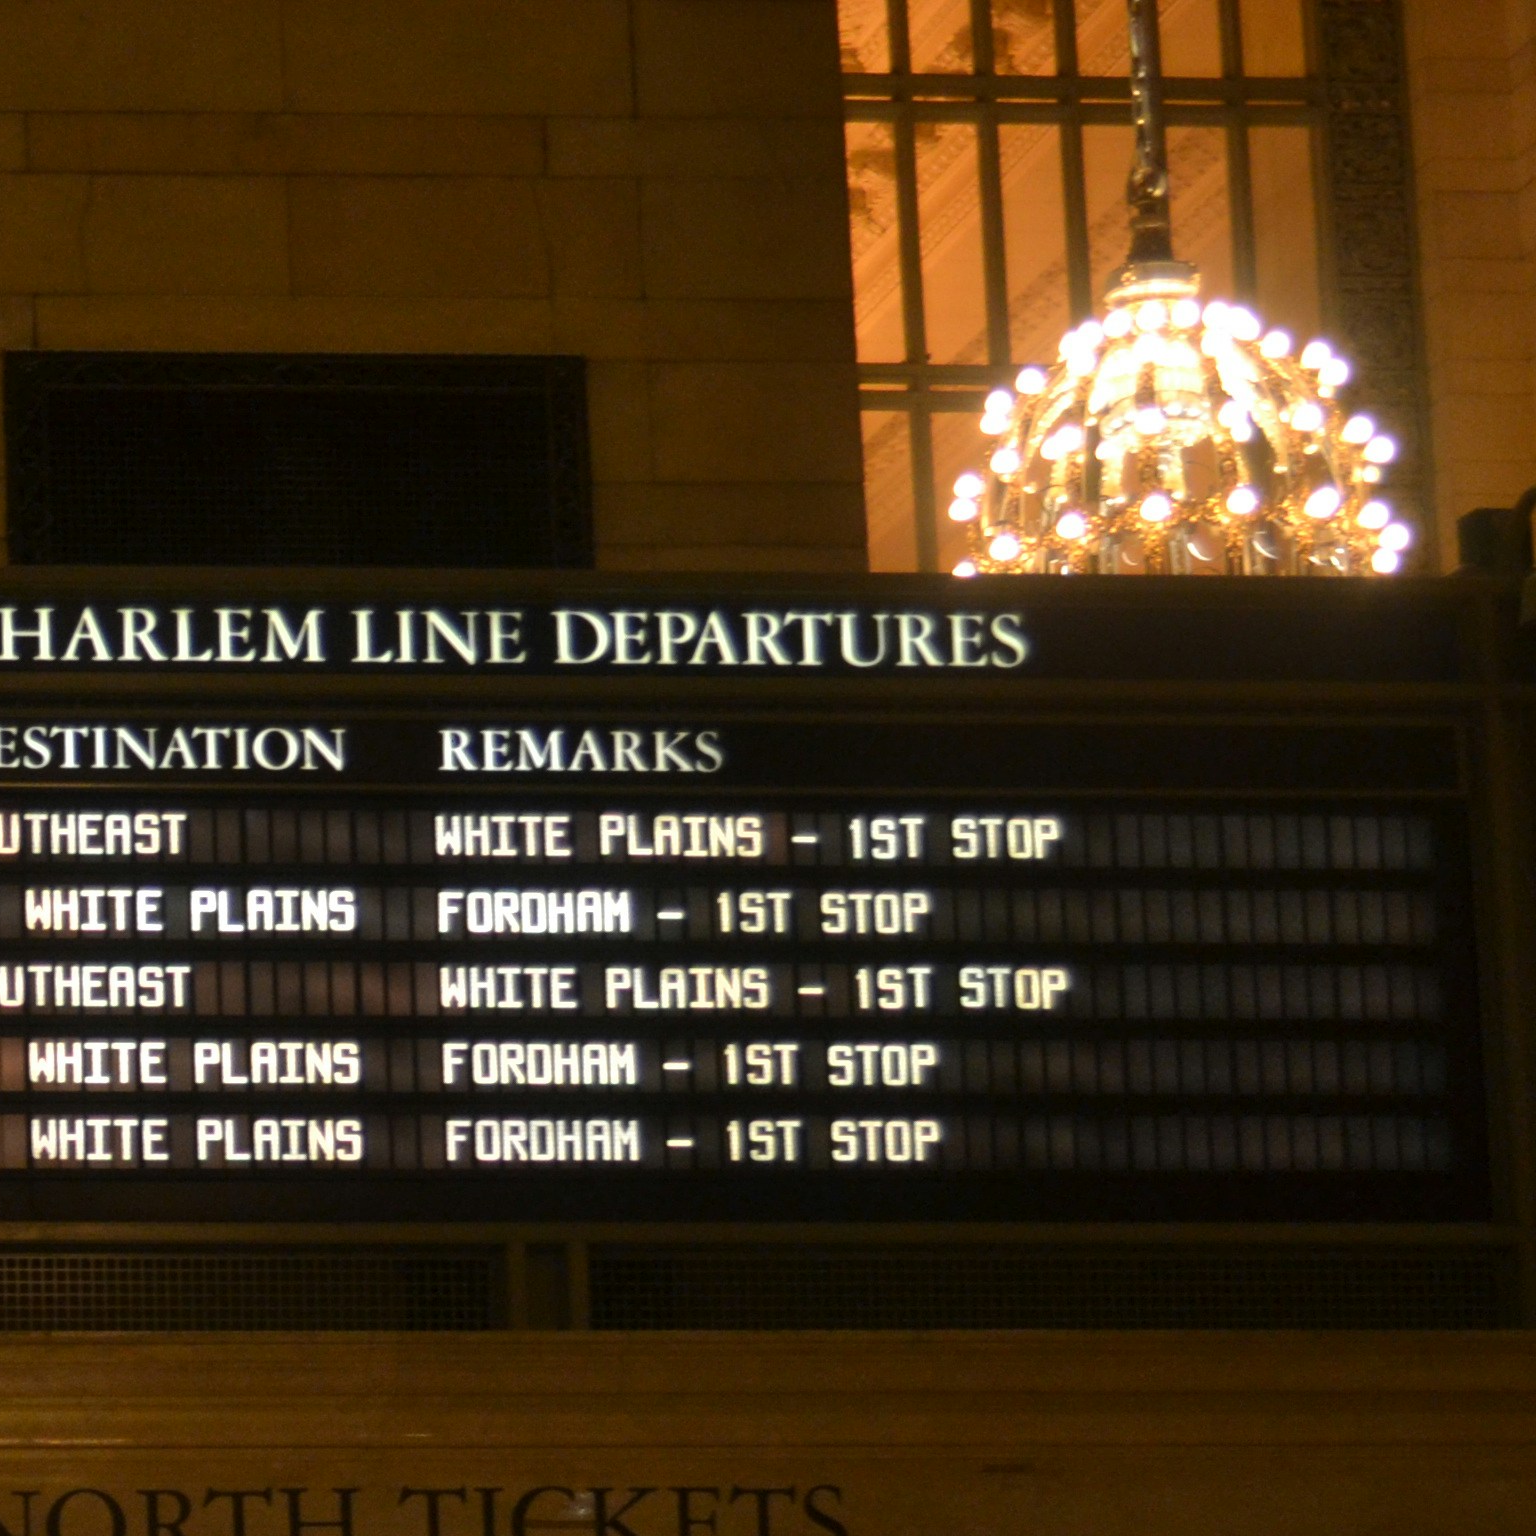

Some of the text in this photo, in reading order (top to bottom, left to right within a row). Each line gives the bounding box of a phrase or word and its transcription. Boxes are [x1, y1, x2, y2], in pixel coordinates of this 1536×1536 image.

[351, 608, 526, 664] LINE
[551, 609, 1028, 668] DEPARTURES
[437, 728, 724, 773] REMARKS
[435, 814, 572, 857] WHITE
[600, 813, 764, 857] PLAINS
[791, 834, 818, 843] -
[849, 816, 924, 859] 1ST
[952, 817, 1062, 859] STOP
[25, 888, 163, 932] WHITE
[190, 888, 357, 933] PLAINS
[438, 889, 634, 934] FORDHAM
[657, 910, 684, 920] -
[717, 891, 791, 933] 1ST
[821, 892, 931, 934] STOP
[440, 966, 578, 1009] WHITE
[605, 967, 770, 1010] PLAINS
[798, 986, 825, 995] -
[856, 966, 932, 1010] 1ST
[959, 966, 1070, 1009] STOP
[29, 1041, 167, 1085] WHITE
[194, 1041, 361, 1084] PLAINS
[443, 1042, 638, 1085] FORDHAM
[663, 1060, 690, 1070] -
[724, 1043, 798, 1085] 1ST
[828, 1044, 939, 1086] STOP
[31, 1117, 169, 1161] WHITE
[197, 1118, 363, 1161] PLAINS
[446, 1119, 640, 1162] FORDHAM
[667, 1138, 693, 1148] -
[727, 1120, 801, 1161] 1ST
[831, 1120, 941, 1161] STOP
